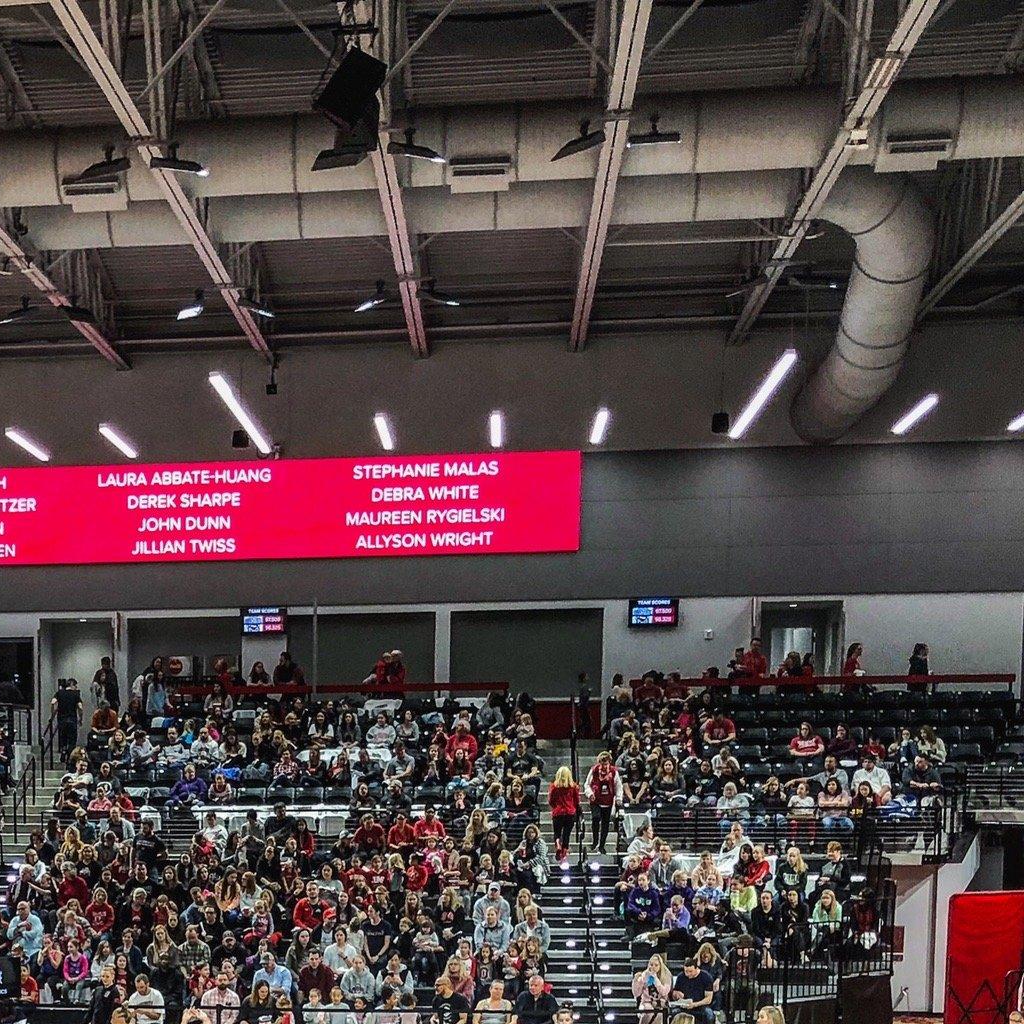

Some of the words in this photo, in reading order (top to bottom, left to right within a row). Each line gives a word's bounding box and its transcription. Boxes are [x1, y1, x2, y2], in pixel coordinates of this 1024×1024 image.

[97, 472, 148, 487] LAURA
[150, 468, 272, 485] ABBATE-HUANG
[352, 463, 440, 479] STEPHANIE
[443, 461, 499, 476] MALAS
[127, 495, 177, 509] DEREK
[179, 492, 241, 507] SHARPE
[371, 487, 426, 502] DEBRA
[428, 485, 480, 500] WHITE
[137, 518, 182, 531] JOHN
[185, 516, 231, 530] DUNN
[345, 511, 423, 525] MAUREEN
[426, 508, 505, 523] RYGIELSKI
[131, 540, 186, 554] JILLIAN
[189, 538, 236, 553] TWISS
[355, 534, 427, 548] ALLYSON
[429, 532, 494, 546] WRIGHT
